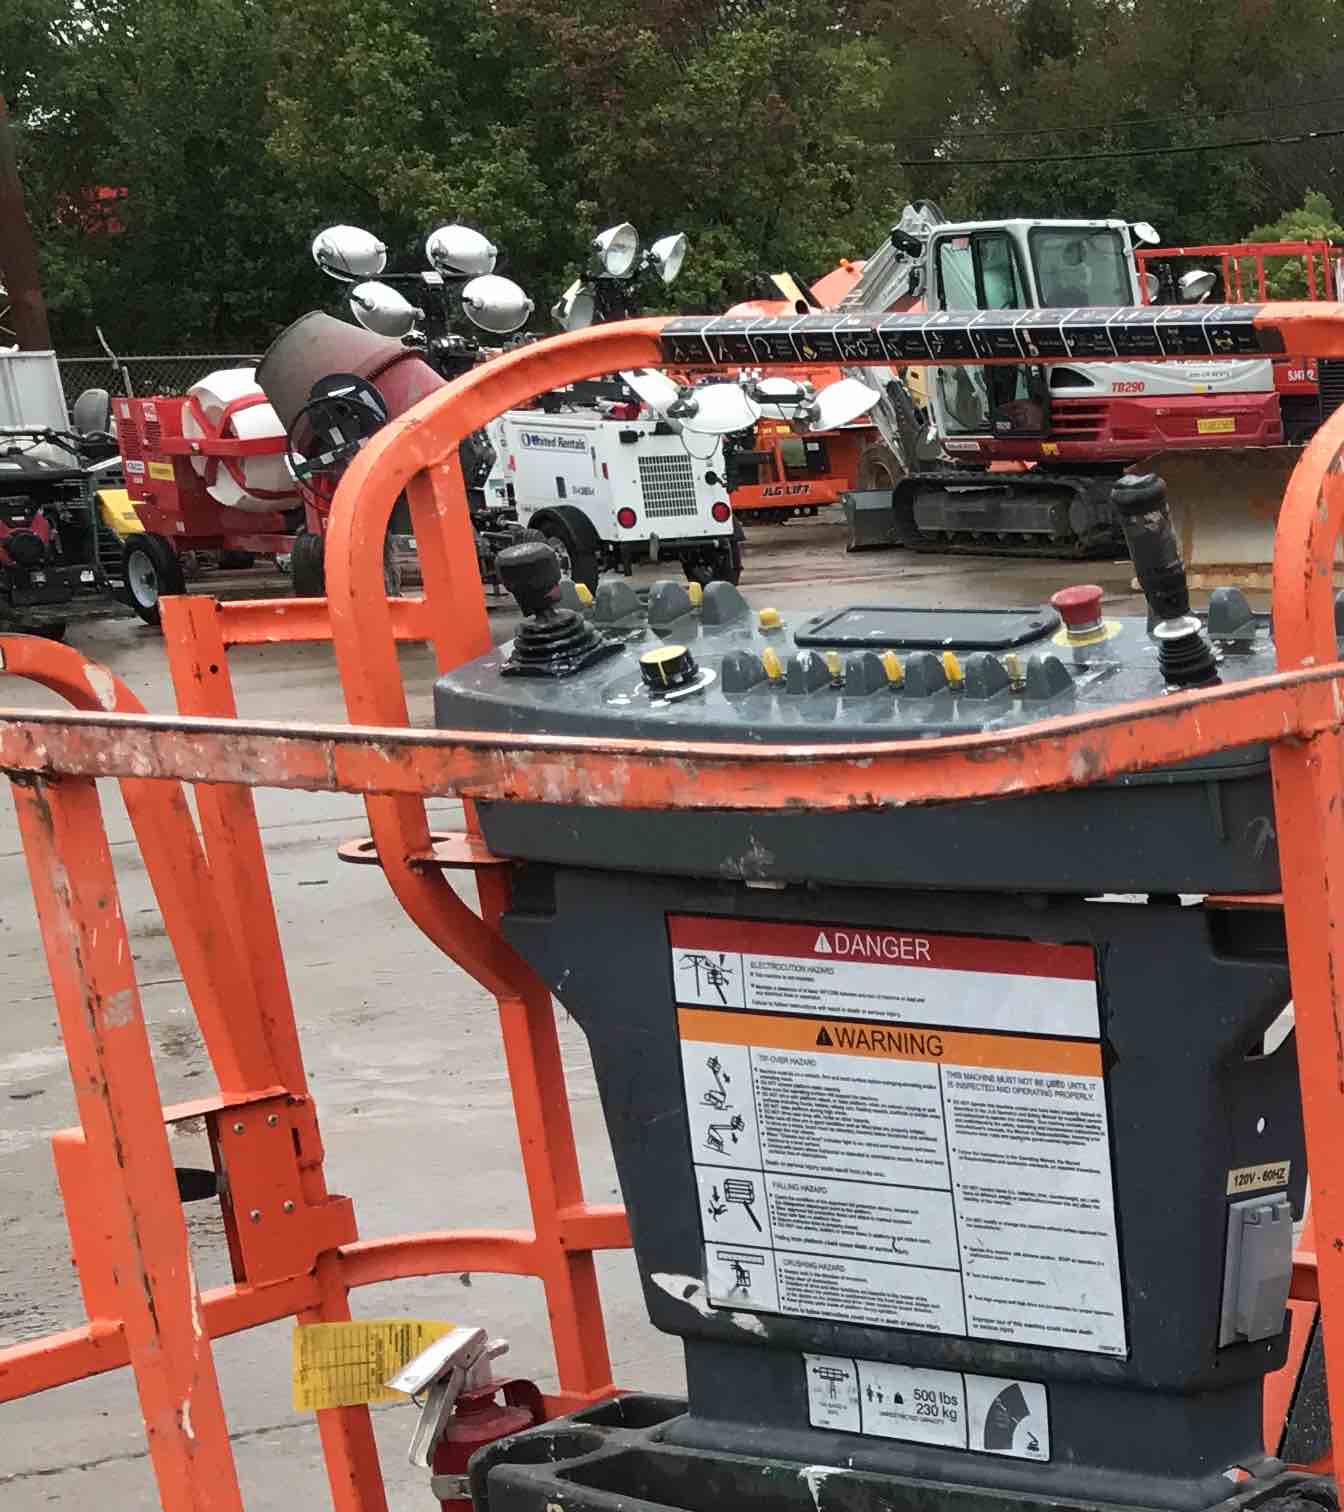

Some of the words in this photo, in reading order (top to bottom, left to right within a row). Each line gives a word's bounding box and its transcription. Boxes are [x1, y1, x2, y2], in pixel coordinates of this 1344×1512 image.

[1111, 381, 1145, 393] TB290
[834, 933, 931, 961] DANGER
[834, 1027, 944, 1057] WARNING
[912, 1387, 936, 1403] 500
[938, 1388, 959, 1406] lbs
[916, 1402, 939, 1417] 230
[941, 1405, 958, 1422] kg
